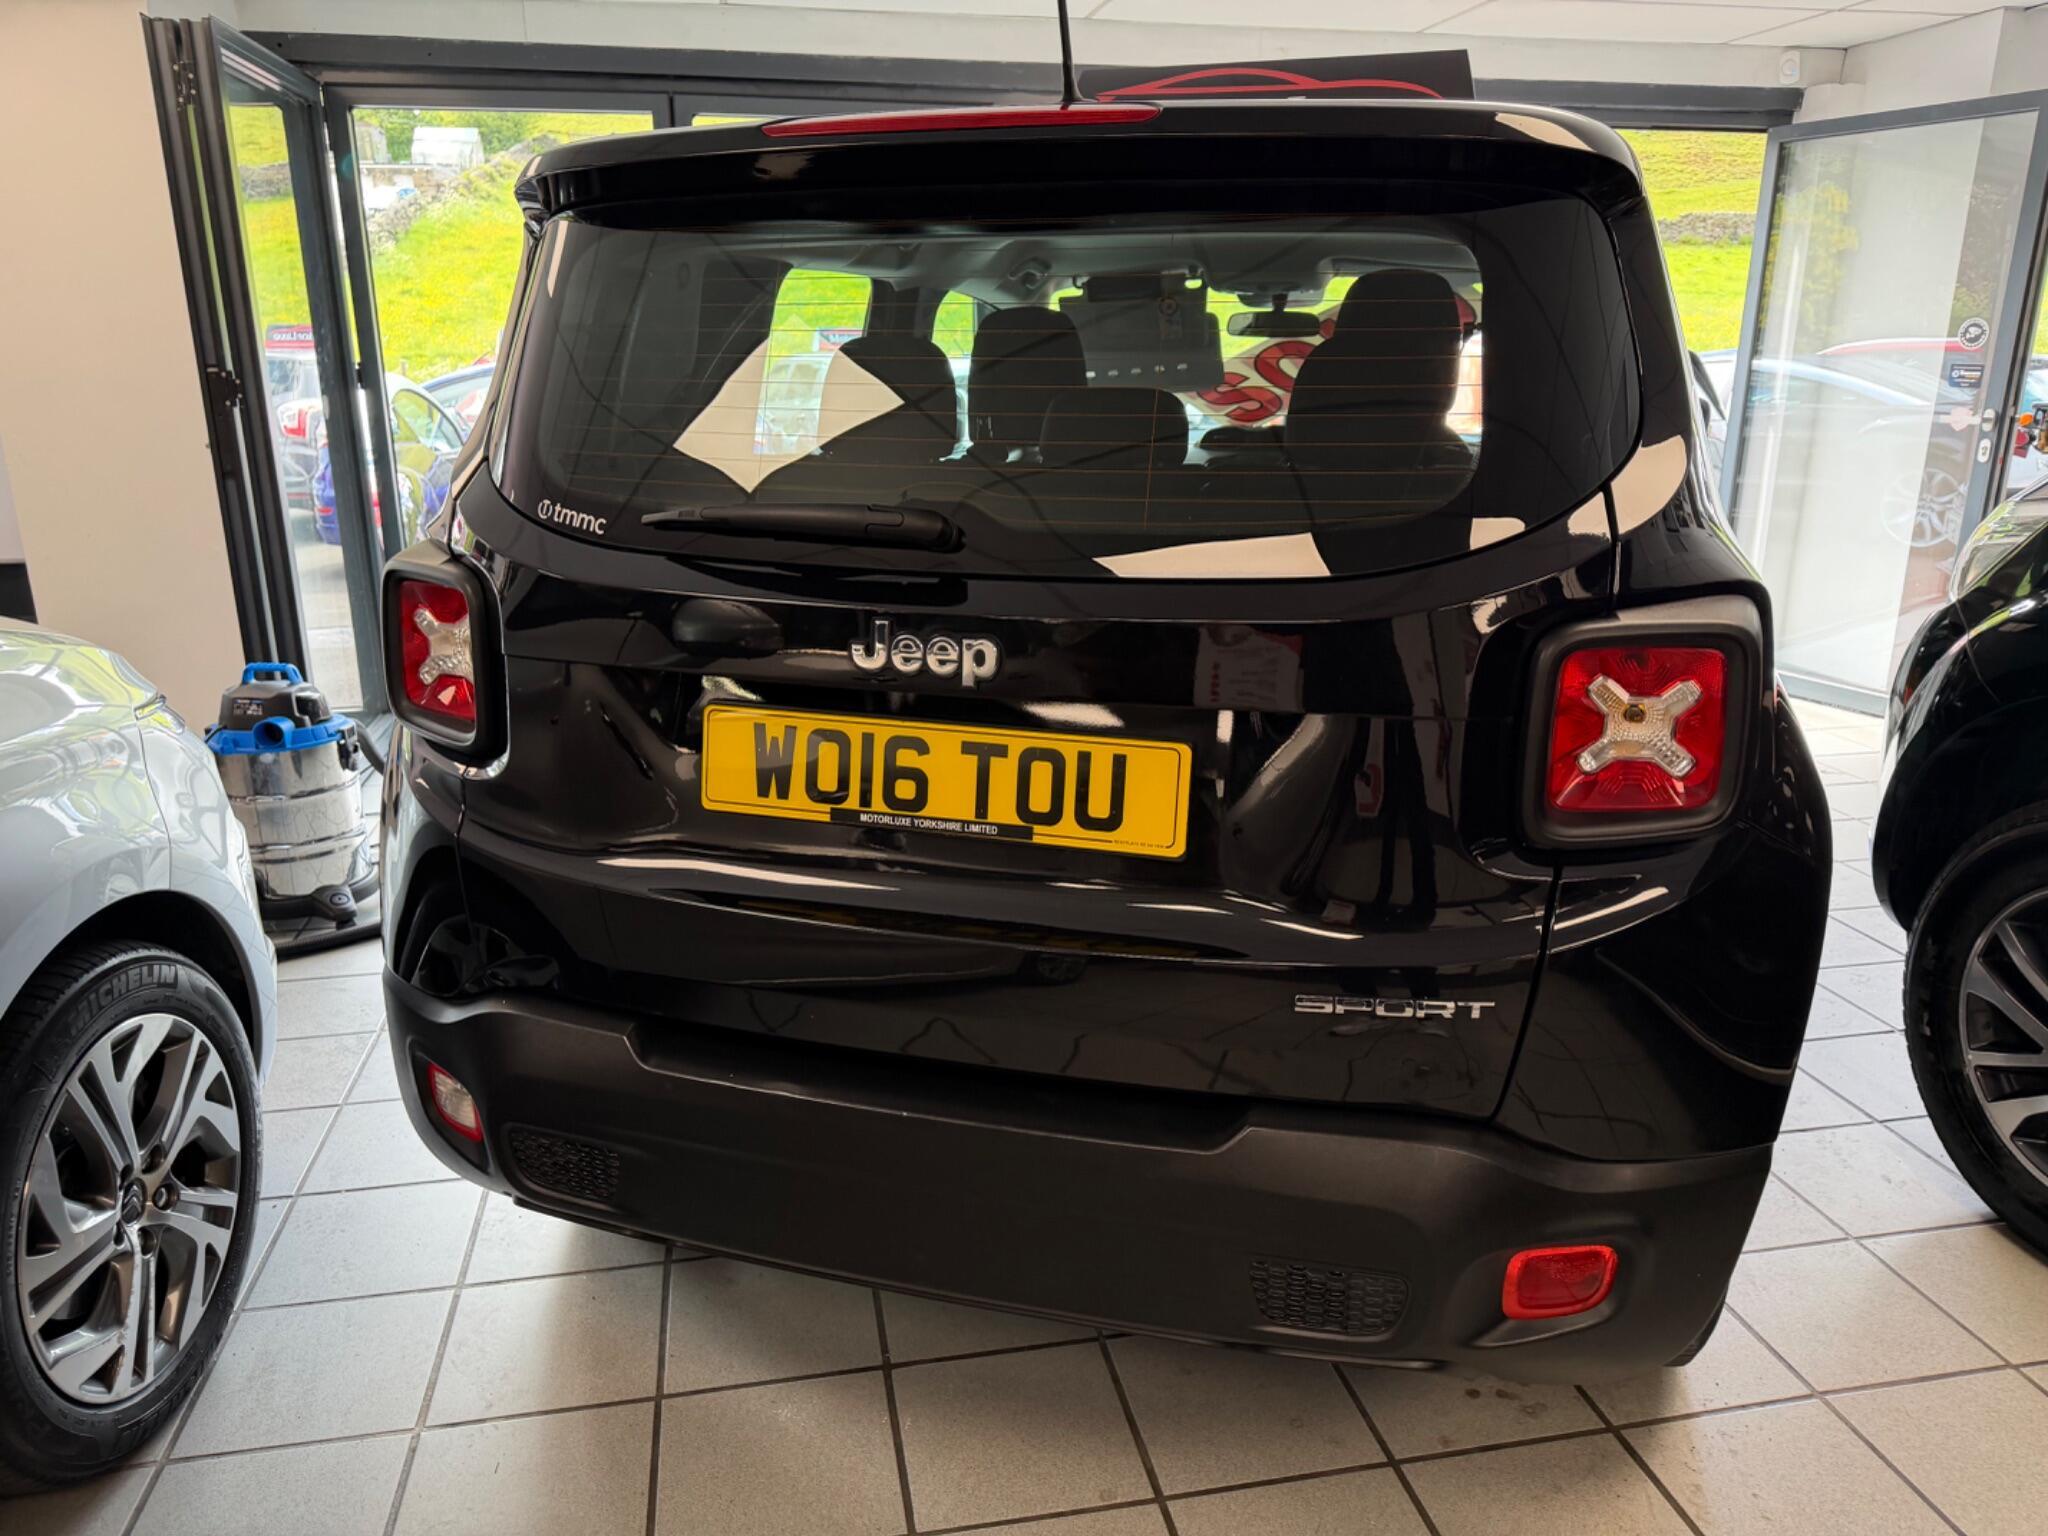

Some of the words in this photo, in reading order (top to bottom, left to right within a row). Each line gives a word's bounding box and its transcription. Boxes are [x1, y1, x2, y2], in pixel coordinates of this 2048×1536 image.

[553, 502, 607, 535] tmmc
[851, 620, 998, 688] Jeep
[753, 721, 931, 814] WO16
[960, 740, 1127, 833] TOU
[859, 812, 912, 827] MOTORLUXE
[913, 818, 963, 832] YORKSHIRE
[964, 823, 998, 835] LIMITED
[68, 964, 178, 1036] MICHELIN
[1294, 994, 1496, 1019] SPORT
